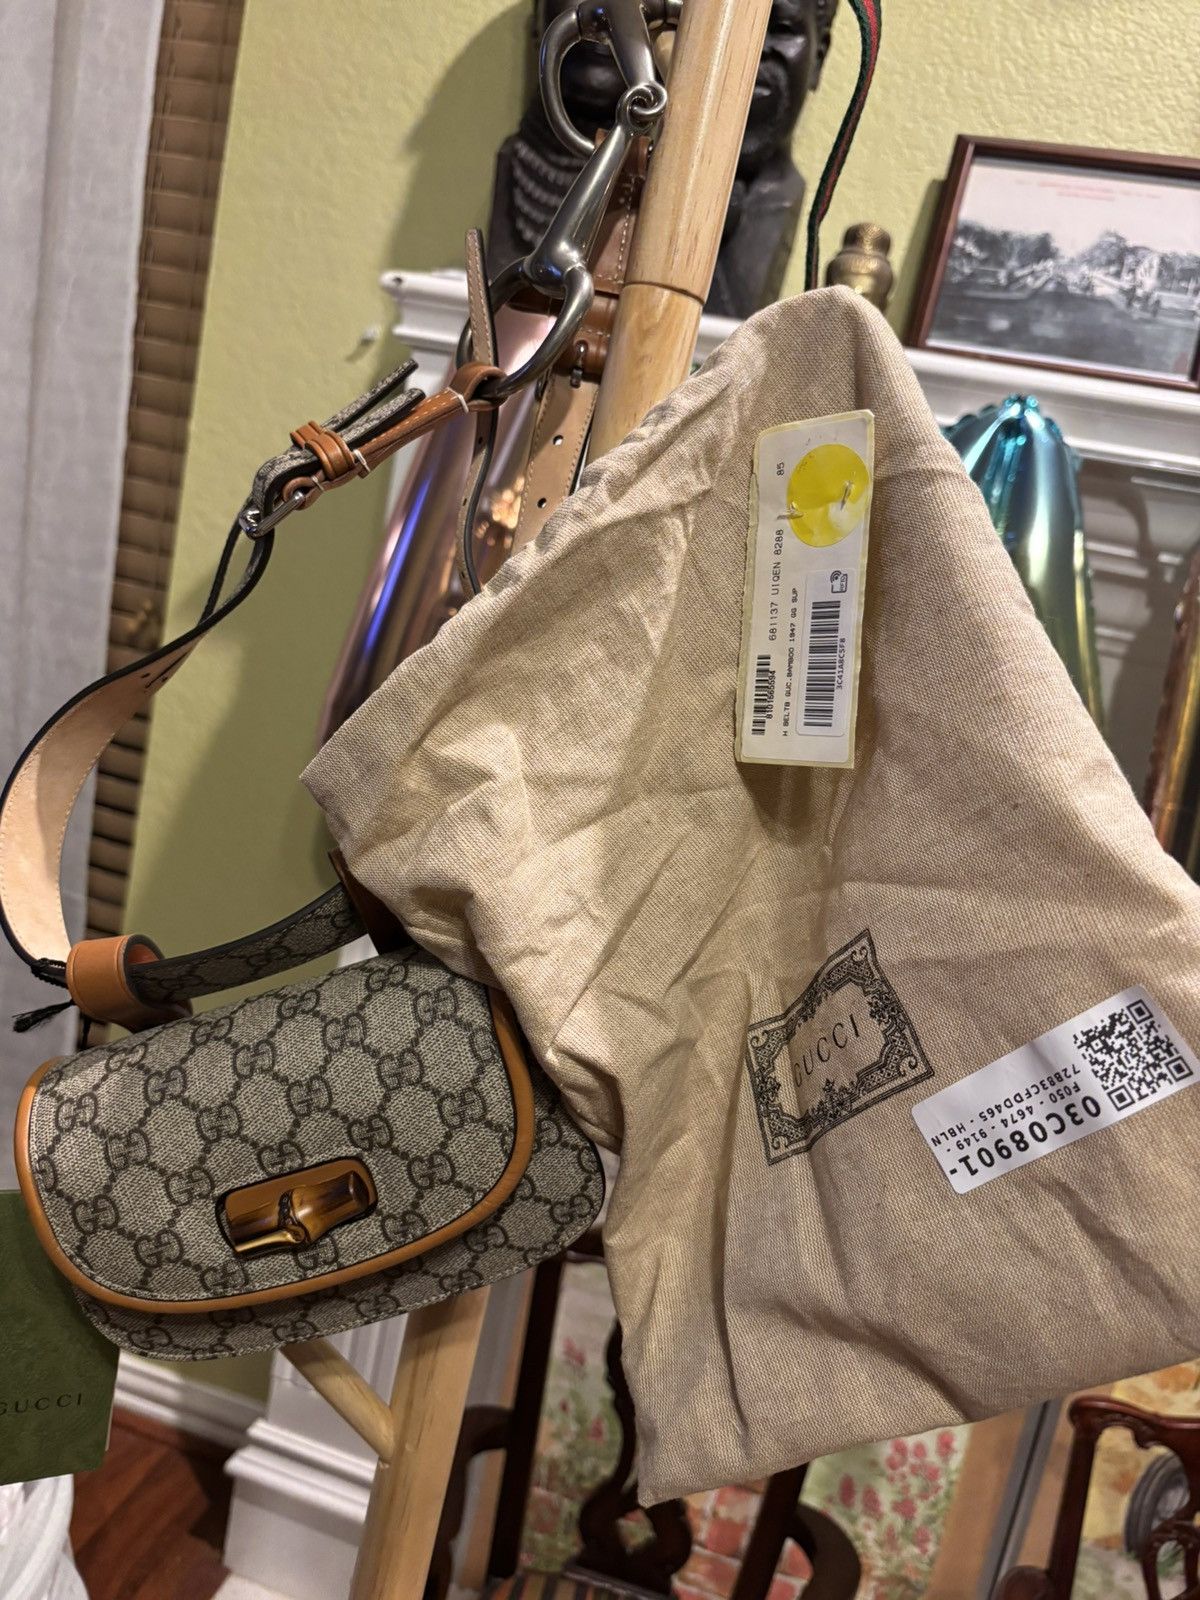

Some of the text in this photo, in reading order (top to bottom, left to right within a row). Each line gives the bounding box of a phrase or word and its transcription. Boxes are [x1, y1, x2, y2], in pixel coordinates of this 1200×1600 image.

[777, 462, 785, 476] 85
[768, 602, 779, 641] 681137
[774, 529, 784, 555] 8288
[791, 587, 799, 602] SUP
[794, 1013, 860, 1088] GUCCI
[1001, 1105, 1034, 1128] 4674
[931, 1122, 967, 1147] HBLN
[949, 1095, 1101, 1176] 03C08901-
[957, 1129, 988, 1151] 9149
